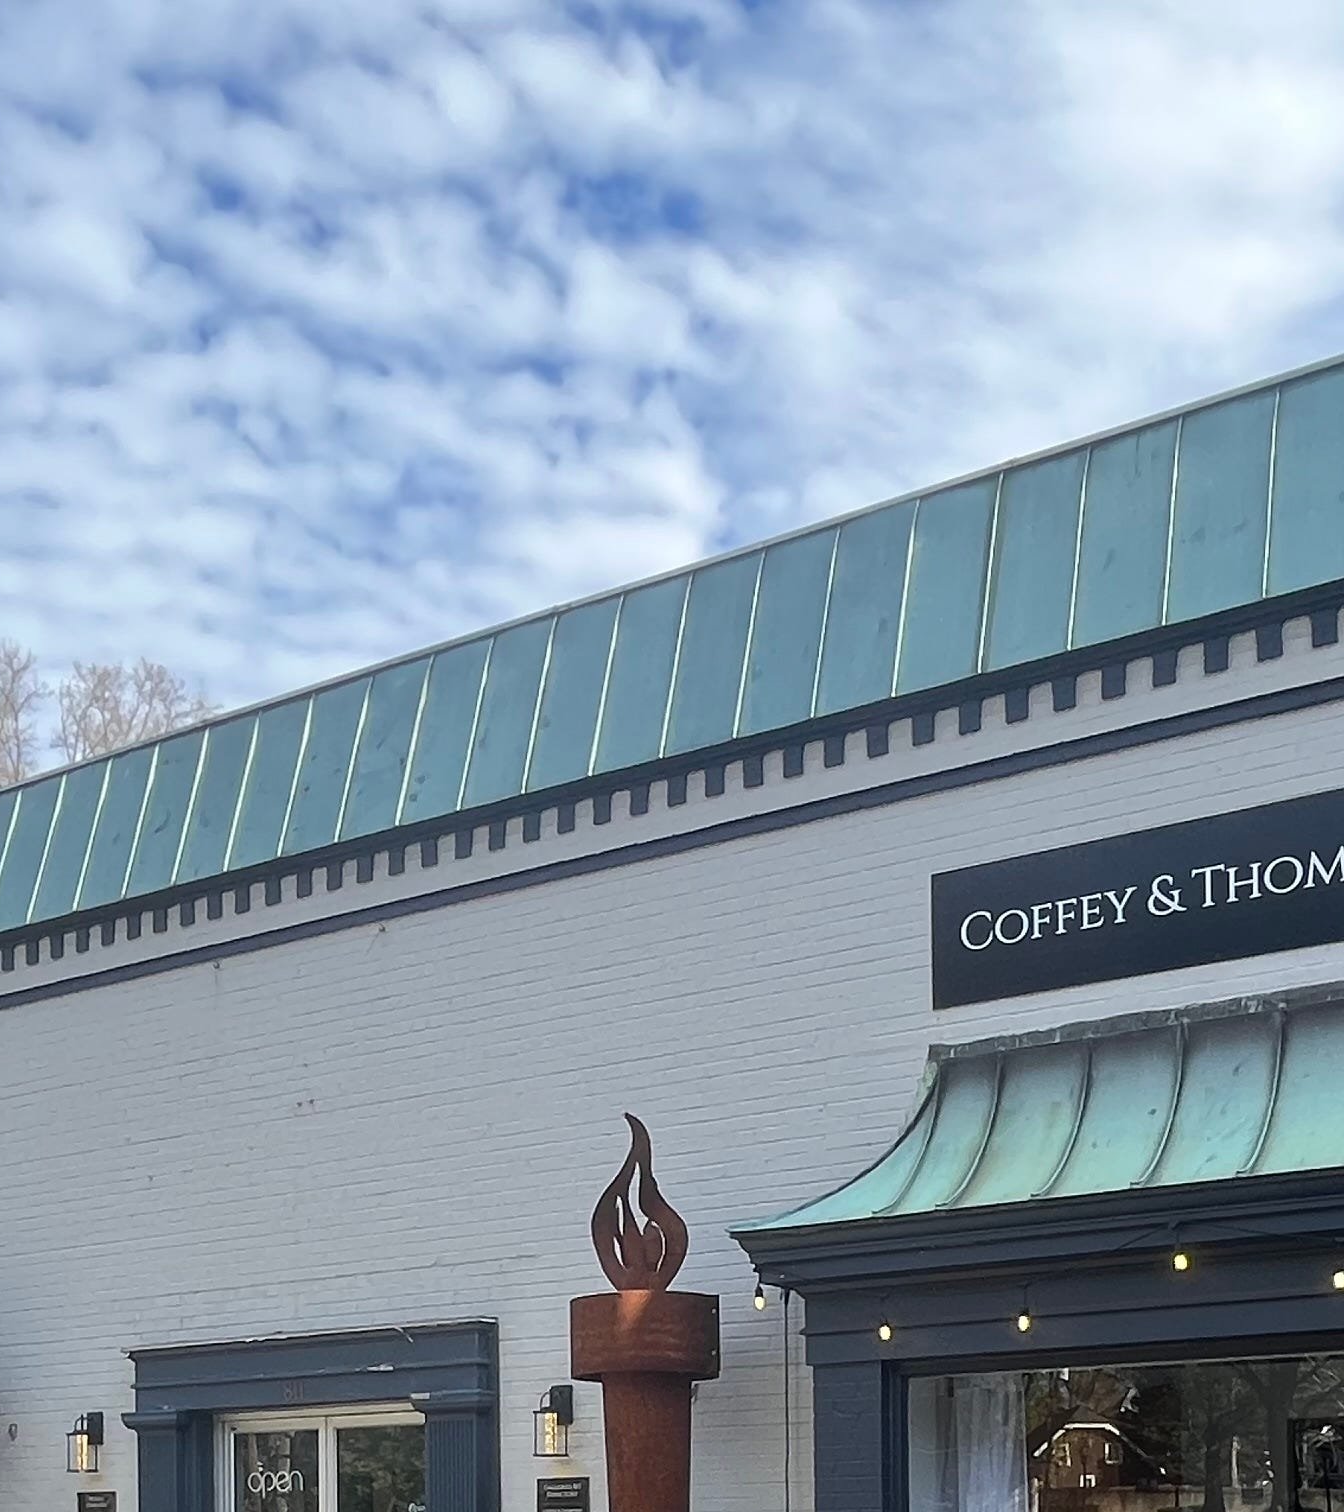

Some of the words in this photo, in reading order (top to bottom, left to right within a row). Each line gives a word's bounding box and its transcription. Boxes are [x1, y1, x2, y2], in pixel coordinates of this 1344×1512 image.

[959, 886, 1138, 950] COFFEY
[1146, 874, 1187, 916] &
[247, 1470, 304, 1499] open
